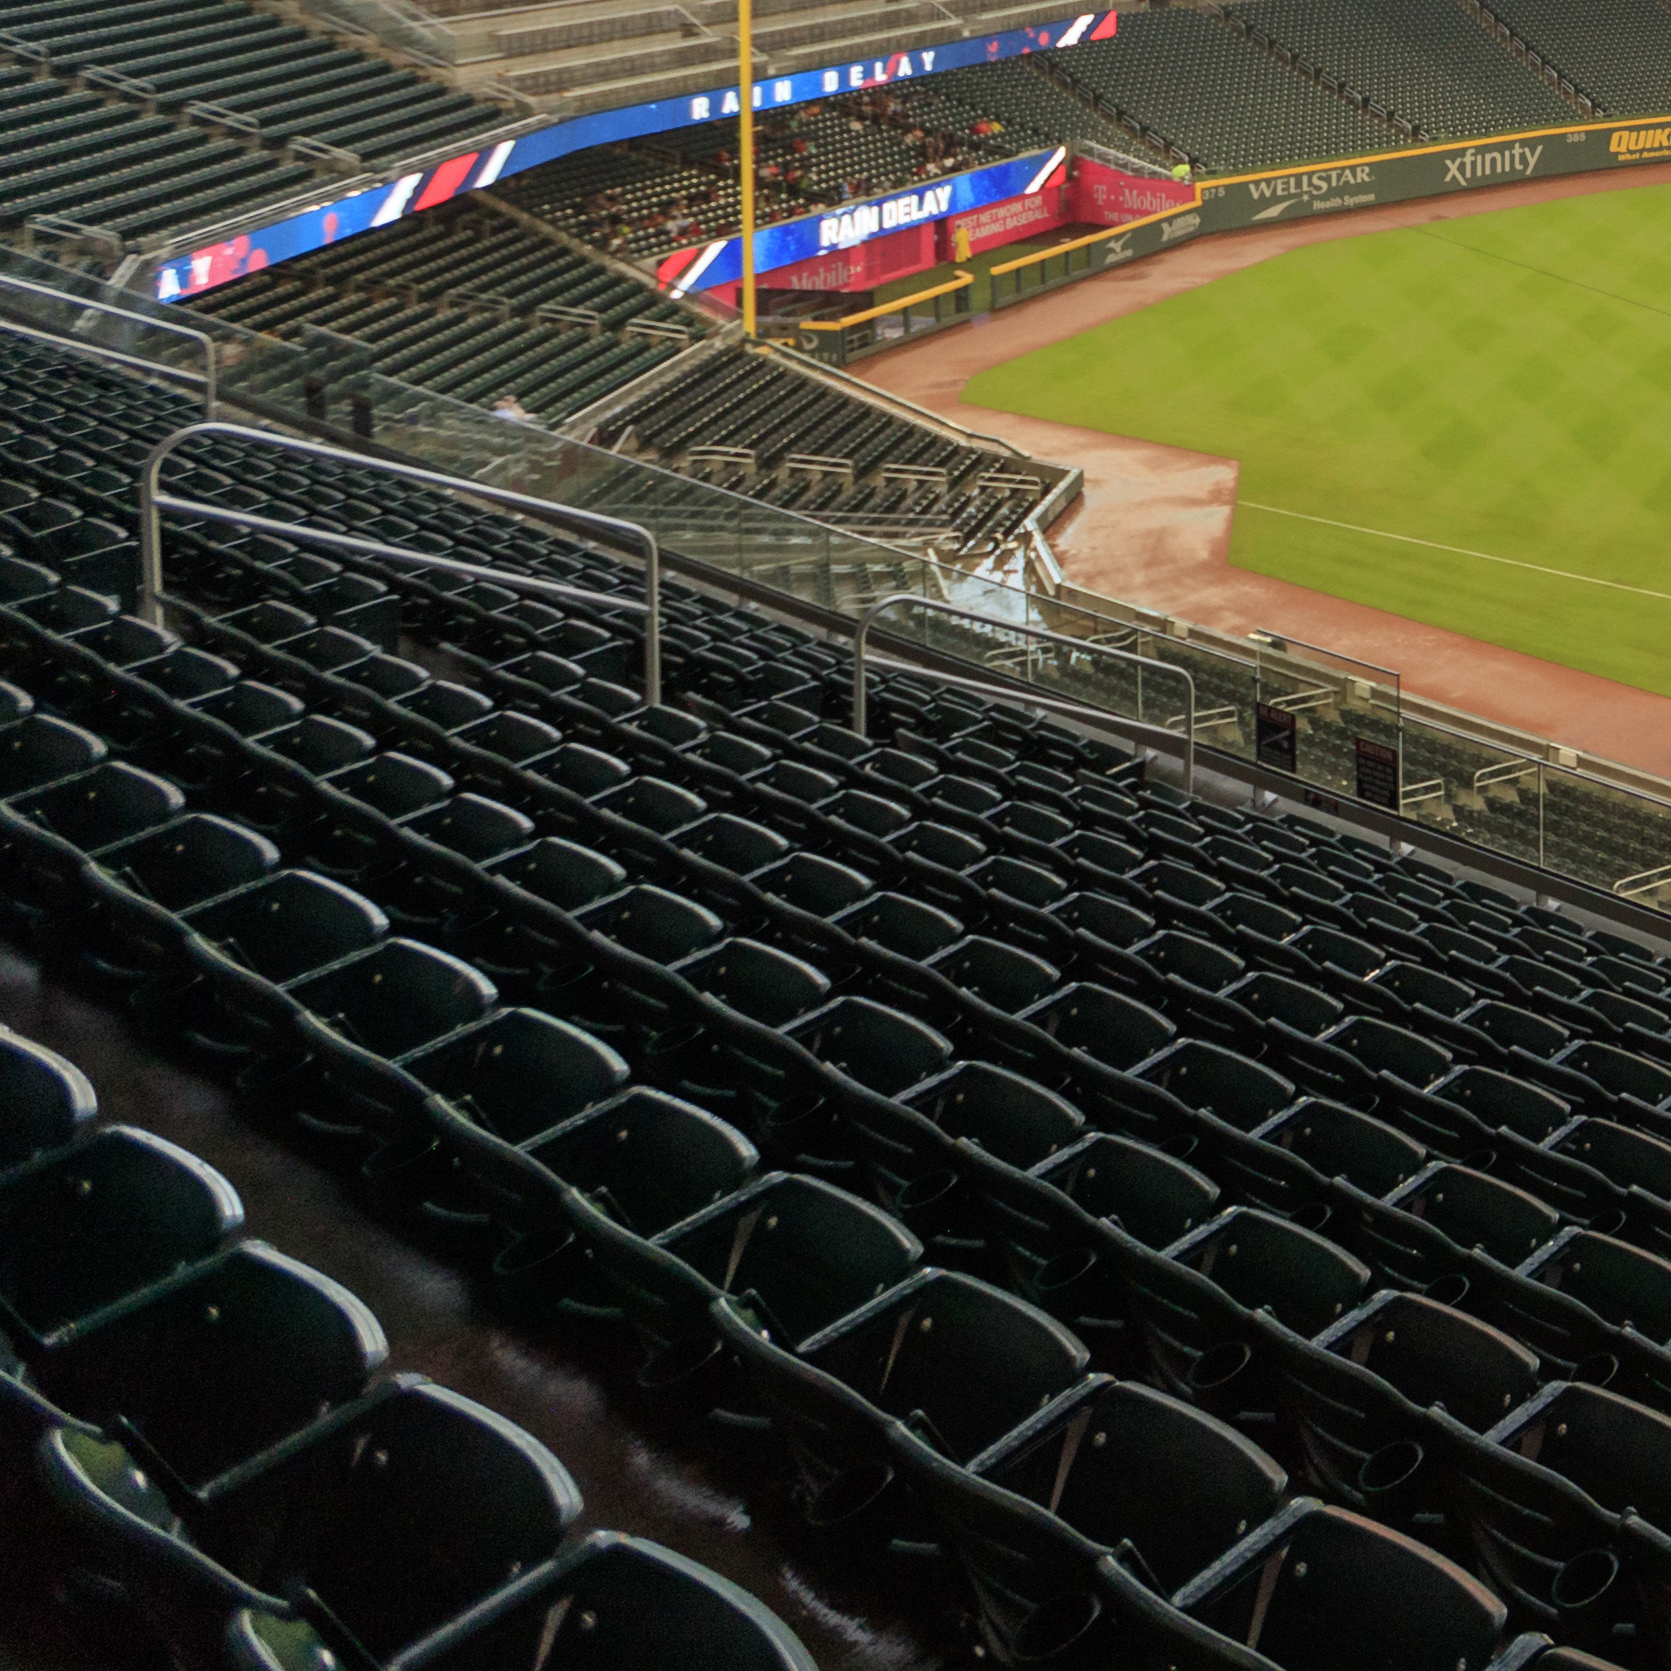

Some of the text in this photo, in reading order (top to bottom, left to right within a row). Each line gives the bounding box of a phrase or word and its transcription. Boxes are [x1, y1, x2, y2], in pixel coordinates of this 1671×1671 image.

[691, 50, 936, 121] RAIN DELAY
[1566, 132, 1586, 143] 385
[1444, 142, 1543, 187] xfinity
[1618, 152, 1640, 163] What
[1202, 186, 1226, 201] 375
[1248, 165, 1371, 201] WELLSTAR
[820, 184, 953, 247] RAIN DELAY
[978, 202, 1023, 227] NETWORK
[1024, 195, 1043, 210] FOR
[1313, 191, 1376, 212] Health System
[1004, 206, 1050, 231] BASEBALL
